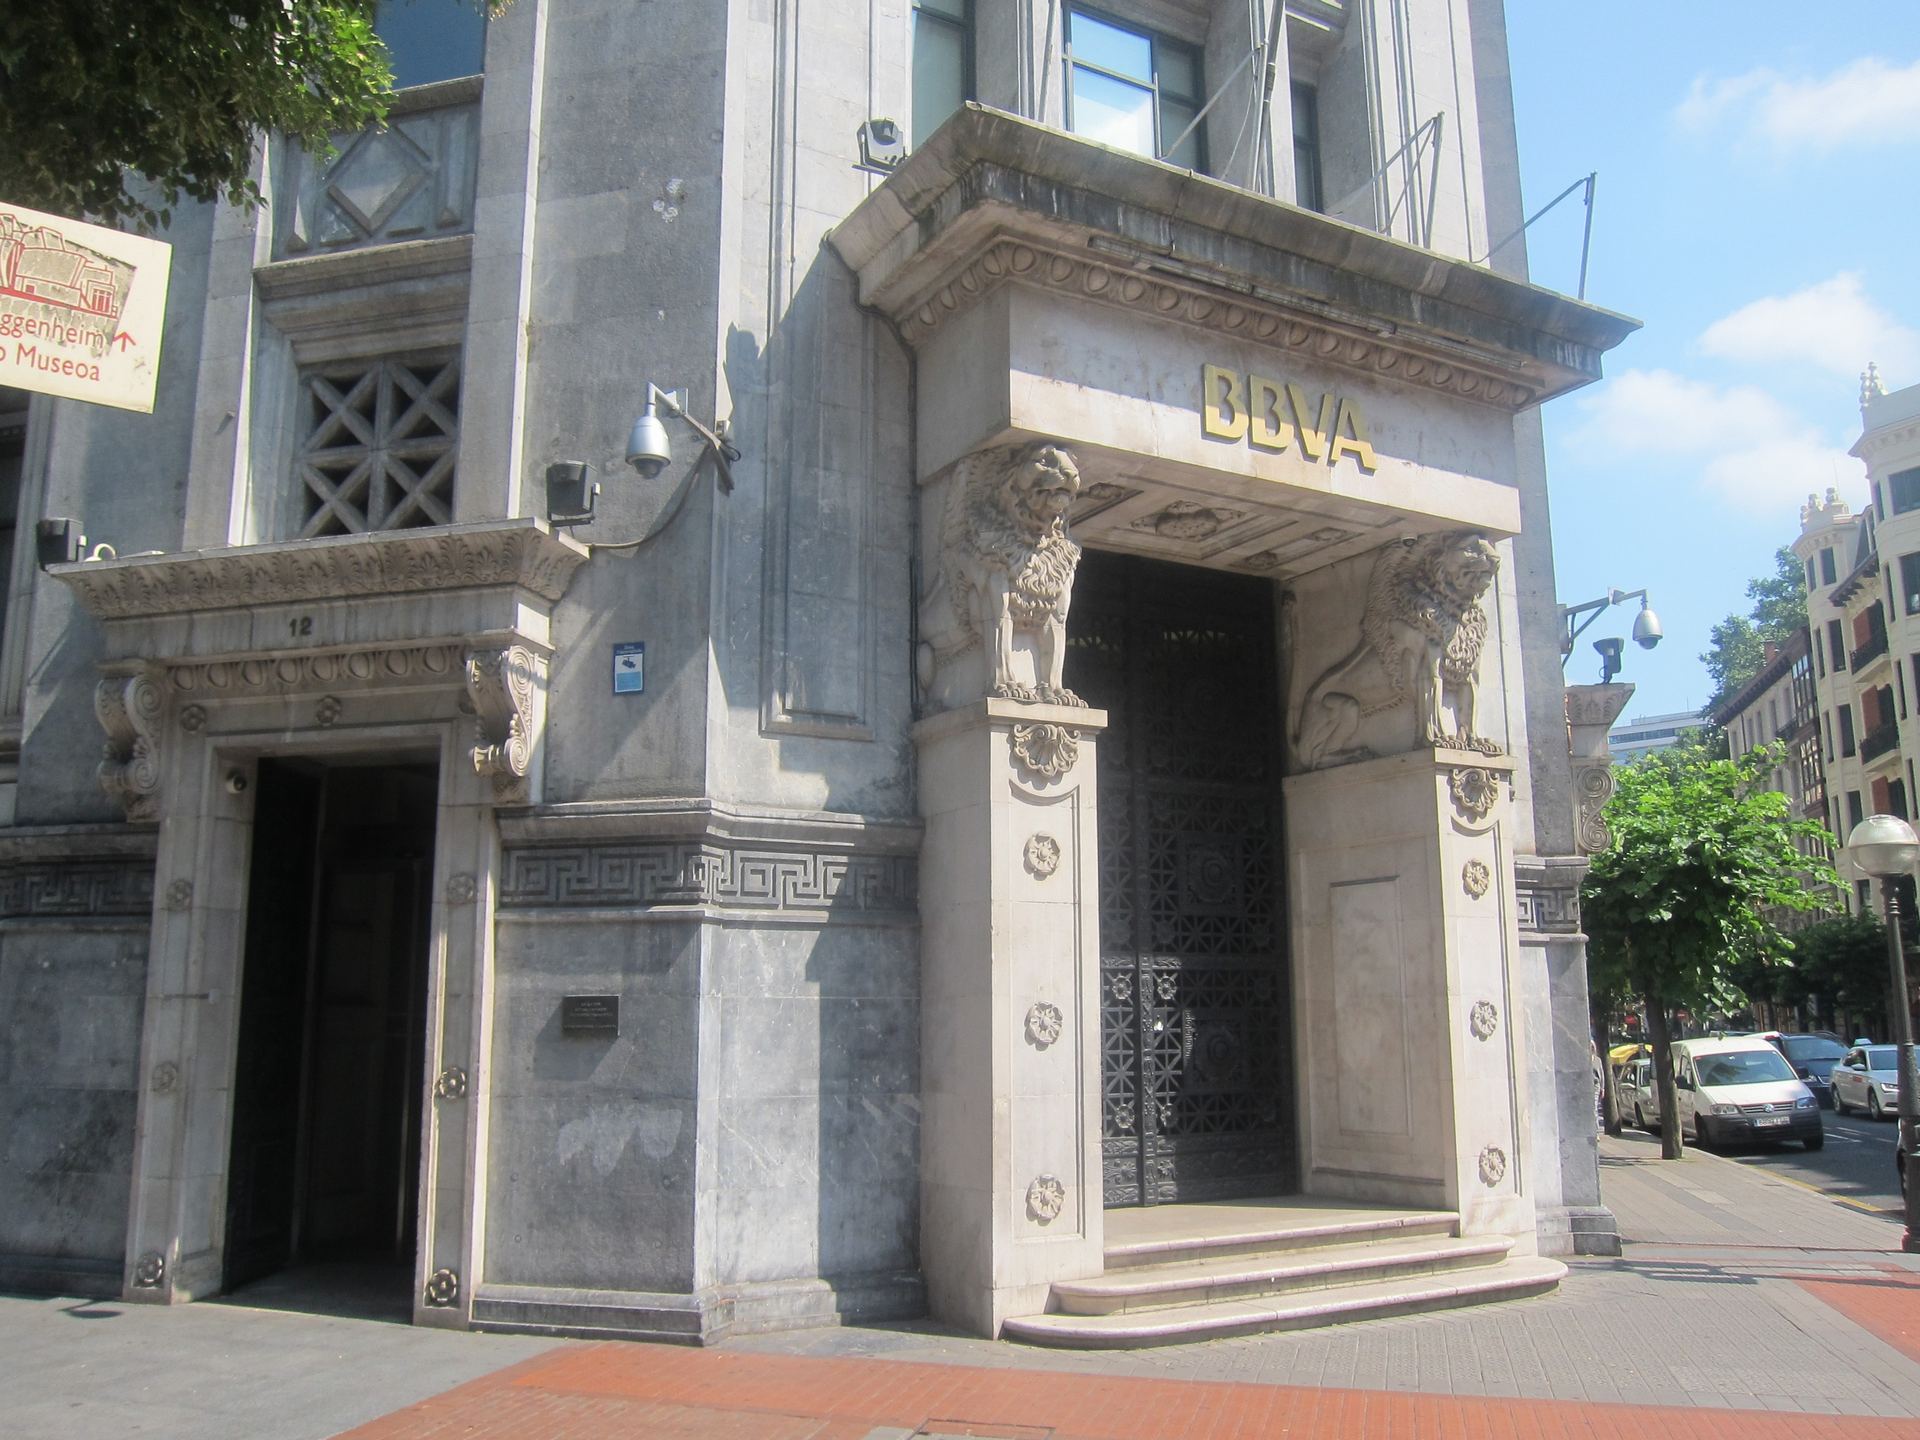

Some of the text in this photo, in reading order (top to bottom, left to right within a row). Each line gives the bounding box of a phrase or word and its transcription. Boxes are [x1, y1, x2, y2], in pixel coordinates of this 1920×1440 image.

[16, 342, 100, 381] Museoa
[1203, 363, 1377, 471] BBVA
[289, 616, 312, 637] 12
